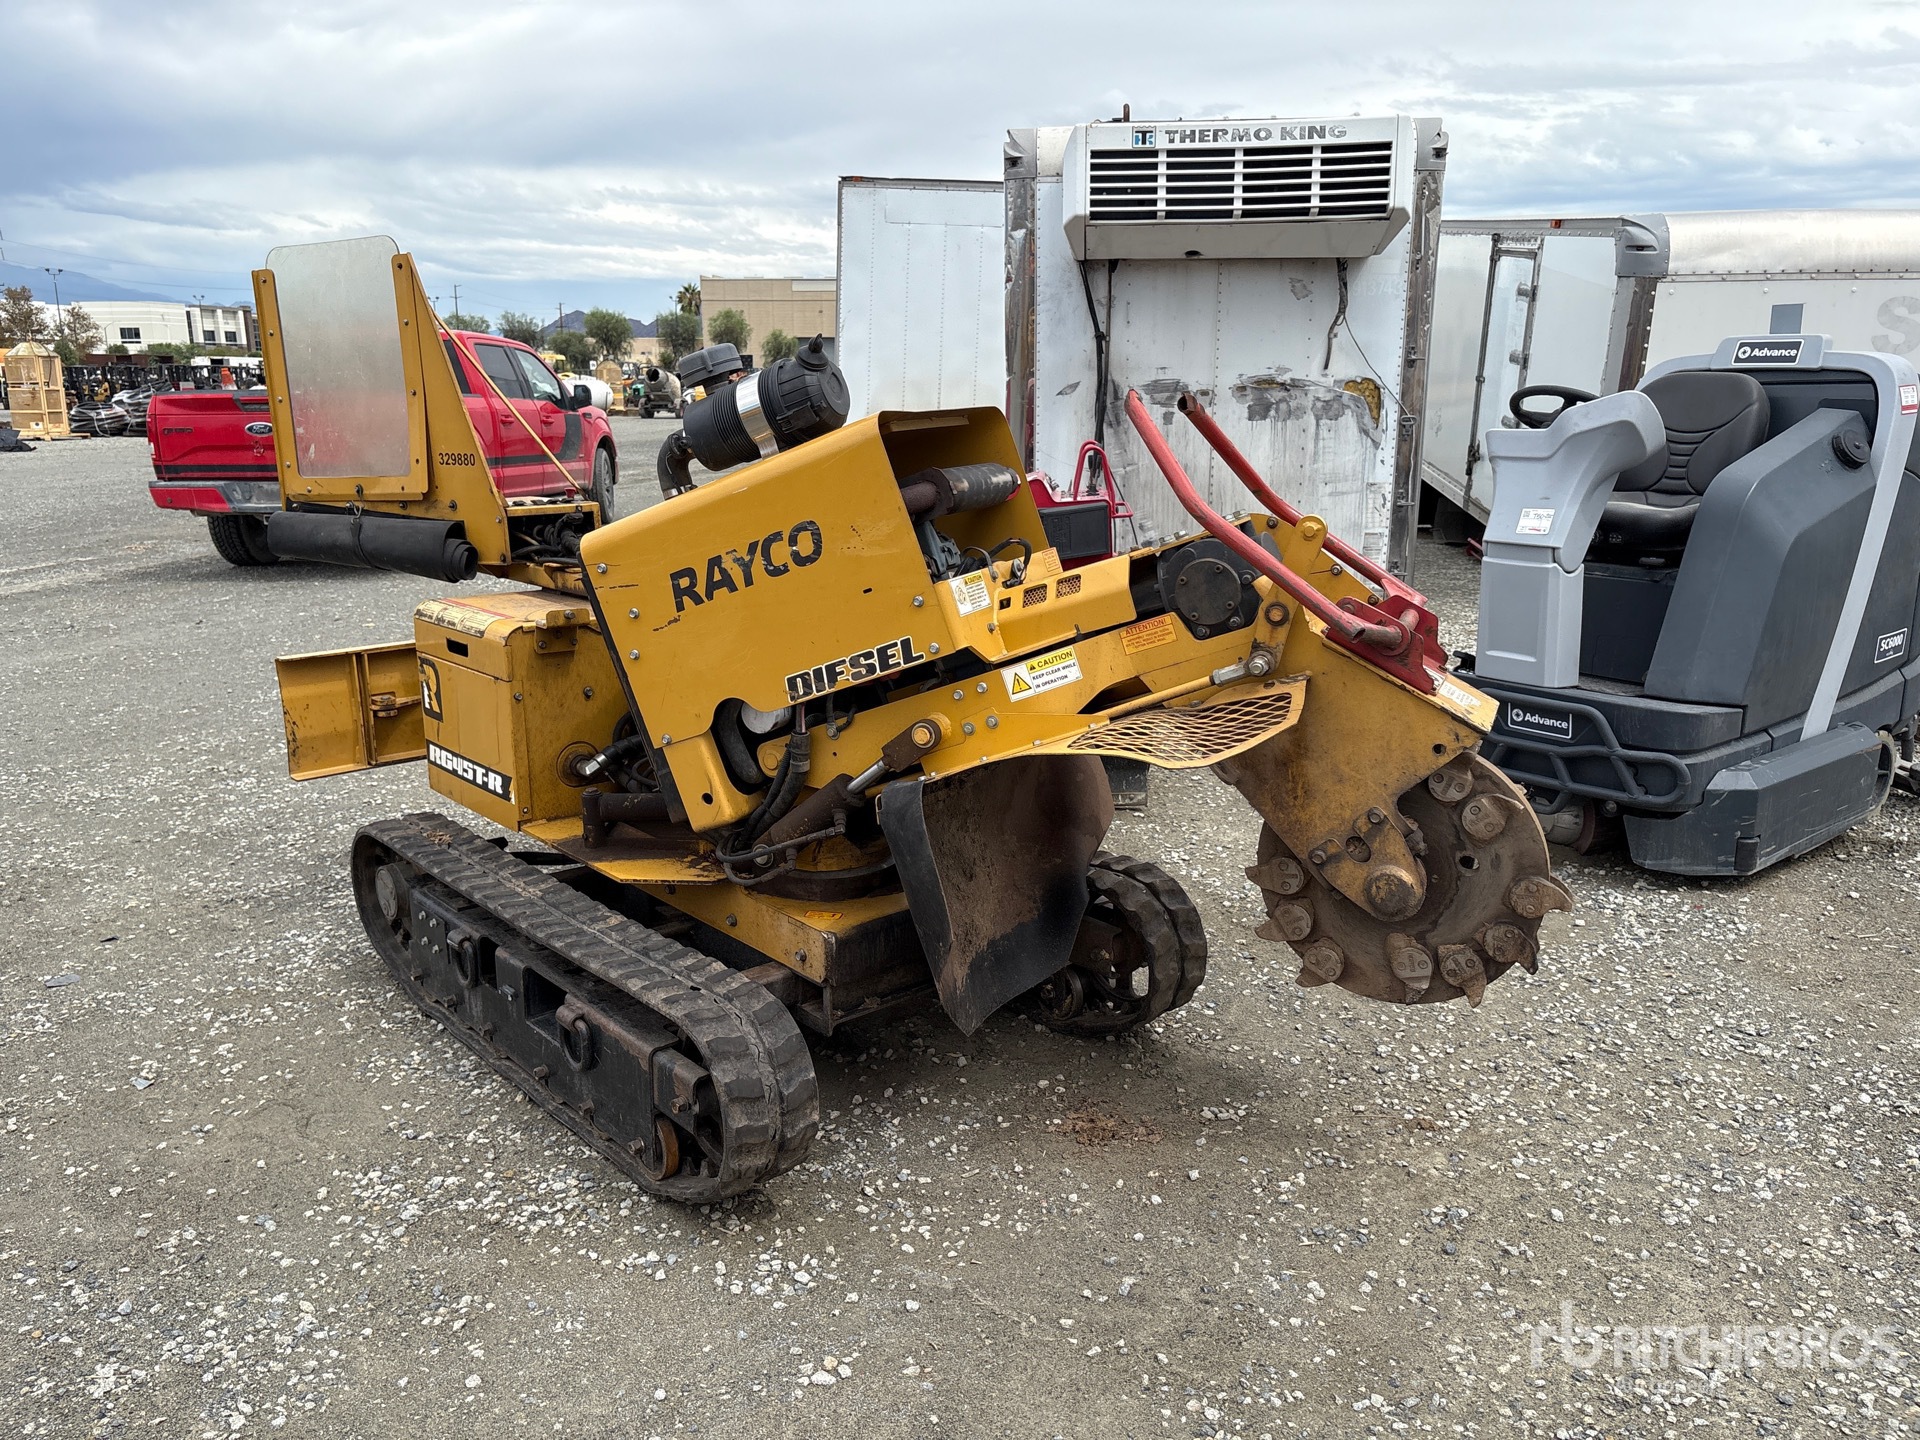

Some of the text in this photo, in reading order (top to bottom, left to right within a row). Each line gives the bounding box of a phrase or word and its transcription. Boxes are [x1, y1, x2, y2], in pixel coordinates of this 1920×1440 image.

[1165, 125, 1347, 144] THERMO KING
[1750, 347, 1798, 357] Advance
[252, 424, 270, 434] Ford
[438, 452, 476, 466] 329880
[669, 519, 823, 613] RAYCO
[1125, 617, 1166, 636] ATTENTION!
[1879, 633, 1904, 652] SC6000
[1037, 650, 1073, 668] CAUTION
[785, 635, 926, 703] DIESEL
[1032, 661, 1077, 681] KEEP CLEAR WHILE
[1041, 674, 1069, 687] OPERATION
[1524, 712, 1569, 730] Advance
[429, 743, 503, 794] RG45T-R
